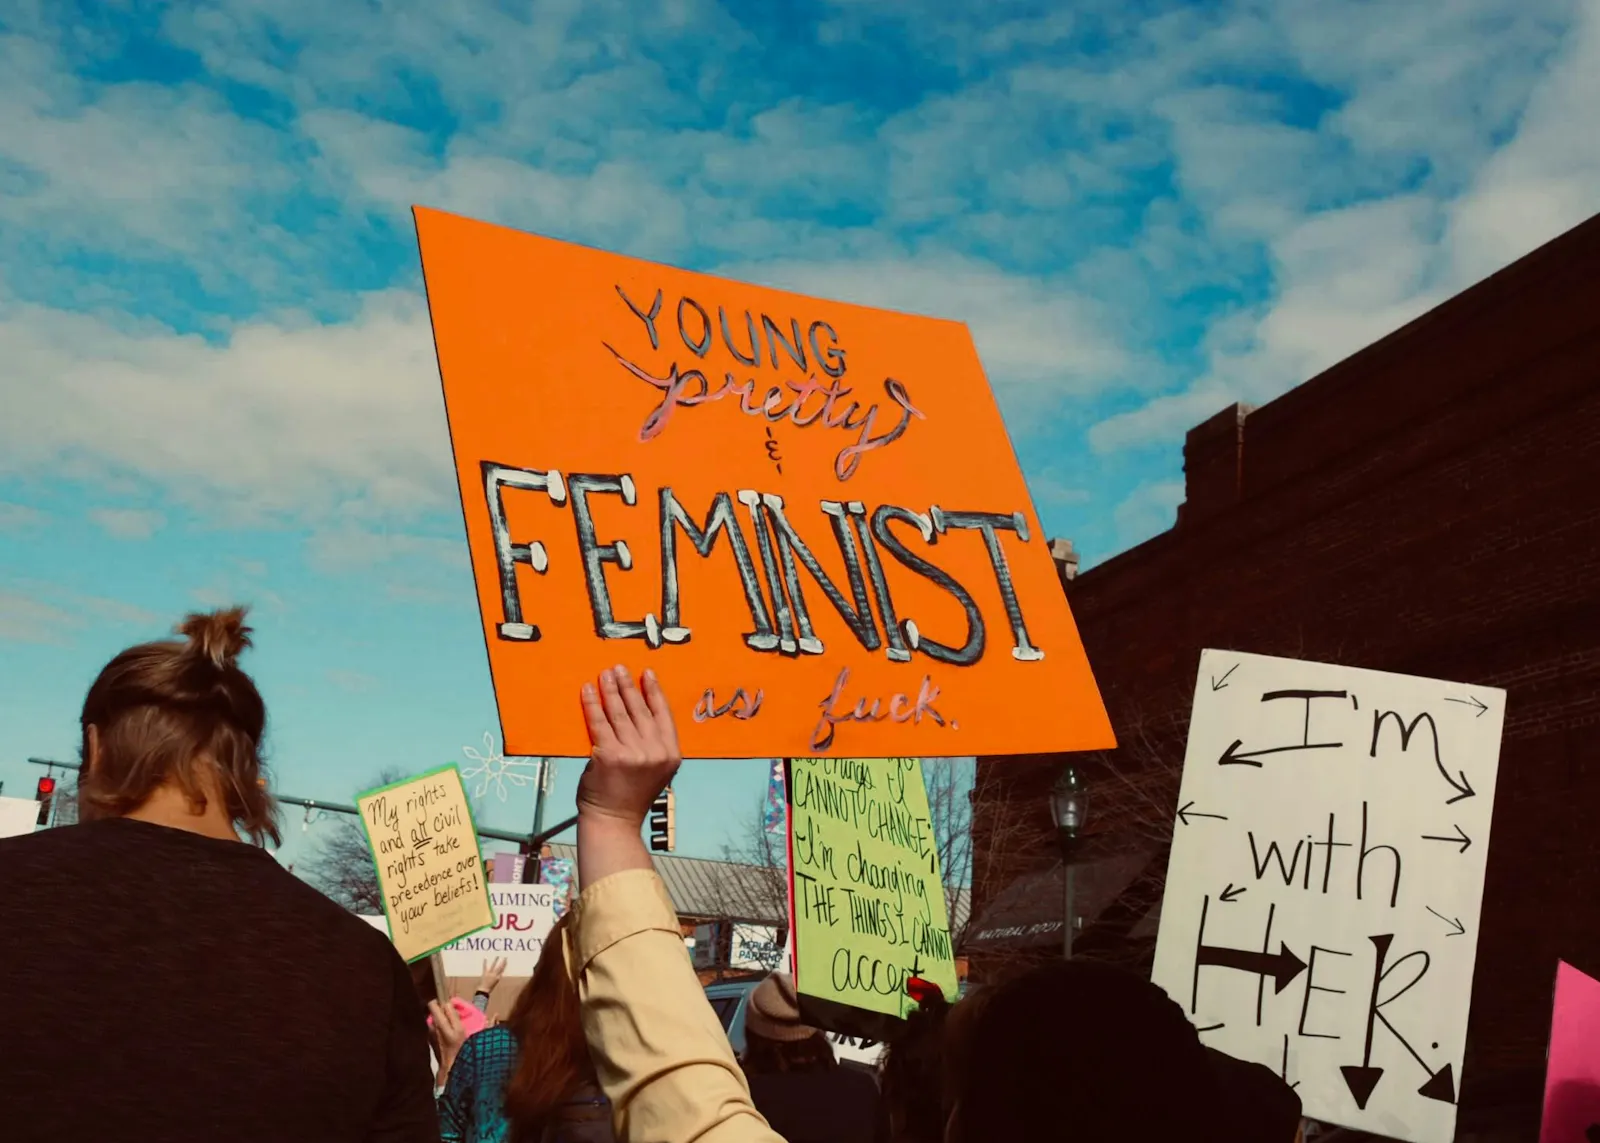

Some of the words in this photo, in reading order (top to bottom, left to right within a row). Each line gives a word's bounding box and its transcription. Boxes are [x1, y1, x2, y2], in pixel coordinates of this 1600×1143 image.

[615, 284, 847, 378] YOUNG
[602, 341, 927, 482] pretty
[480, 461, 1045, 667] FEMINIST
[692, 686, 764, 722] as
[808, 667, 959, 752] fuck.
[1219, 690, 1475, 804] I'm
[368, 796, 399, 831] My
[406, 784, 446, 823] rights
[380, 831, 404, 855] and
[411, 822, 432, 847] all
[433, 806, 461, 833] civil
[795, 768, 858, 829] CANNOT
[387, 851, 425, 888] rights
[433, 836, 460, 857] take
[391, 867, 453, 914] precedence
[456, 856, 478, 873] over
[795, 816, 838, 880] I'm
[848, 840, 931, 926] changing
[1248, 801, 1401, 908] with
[400, 901, 428, 935] your
[434, 872, 479, 906] beliefs!
[795, 871, 839, 927] THE
[840, 888, 897, 945] THINGS
[913, 917, 951, 961] CANNOT
[977, 925, 1027, 940] NATURAL
[1192, 894, 1458, 1110] HER.
